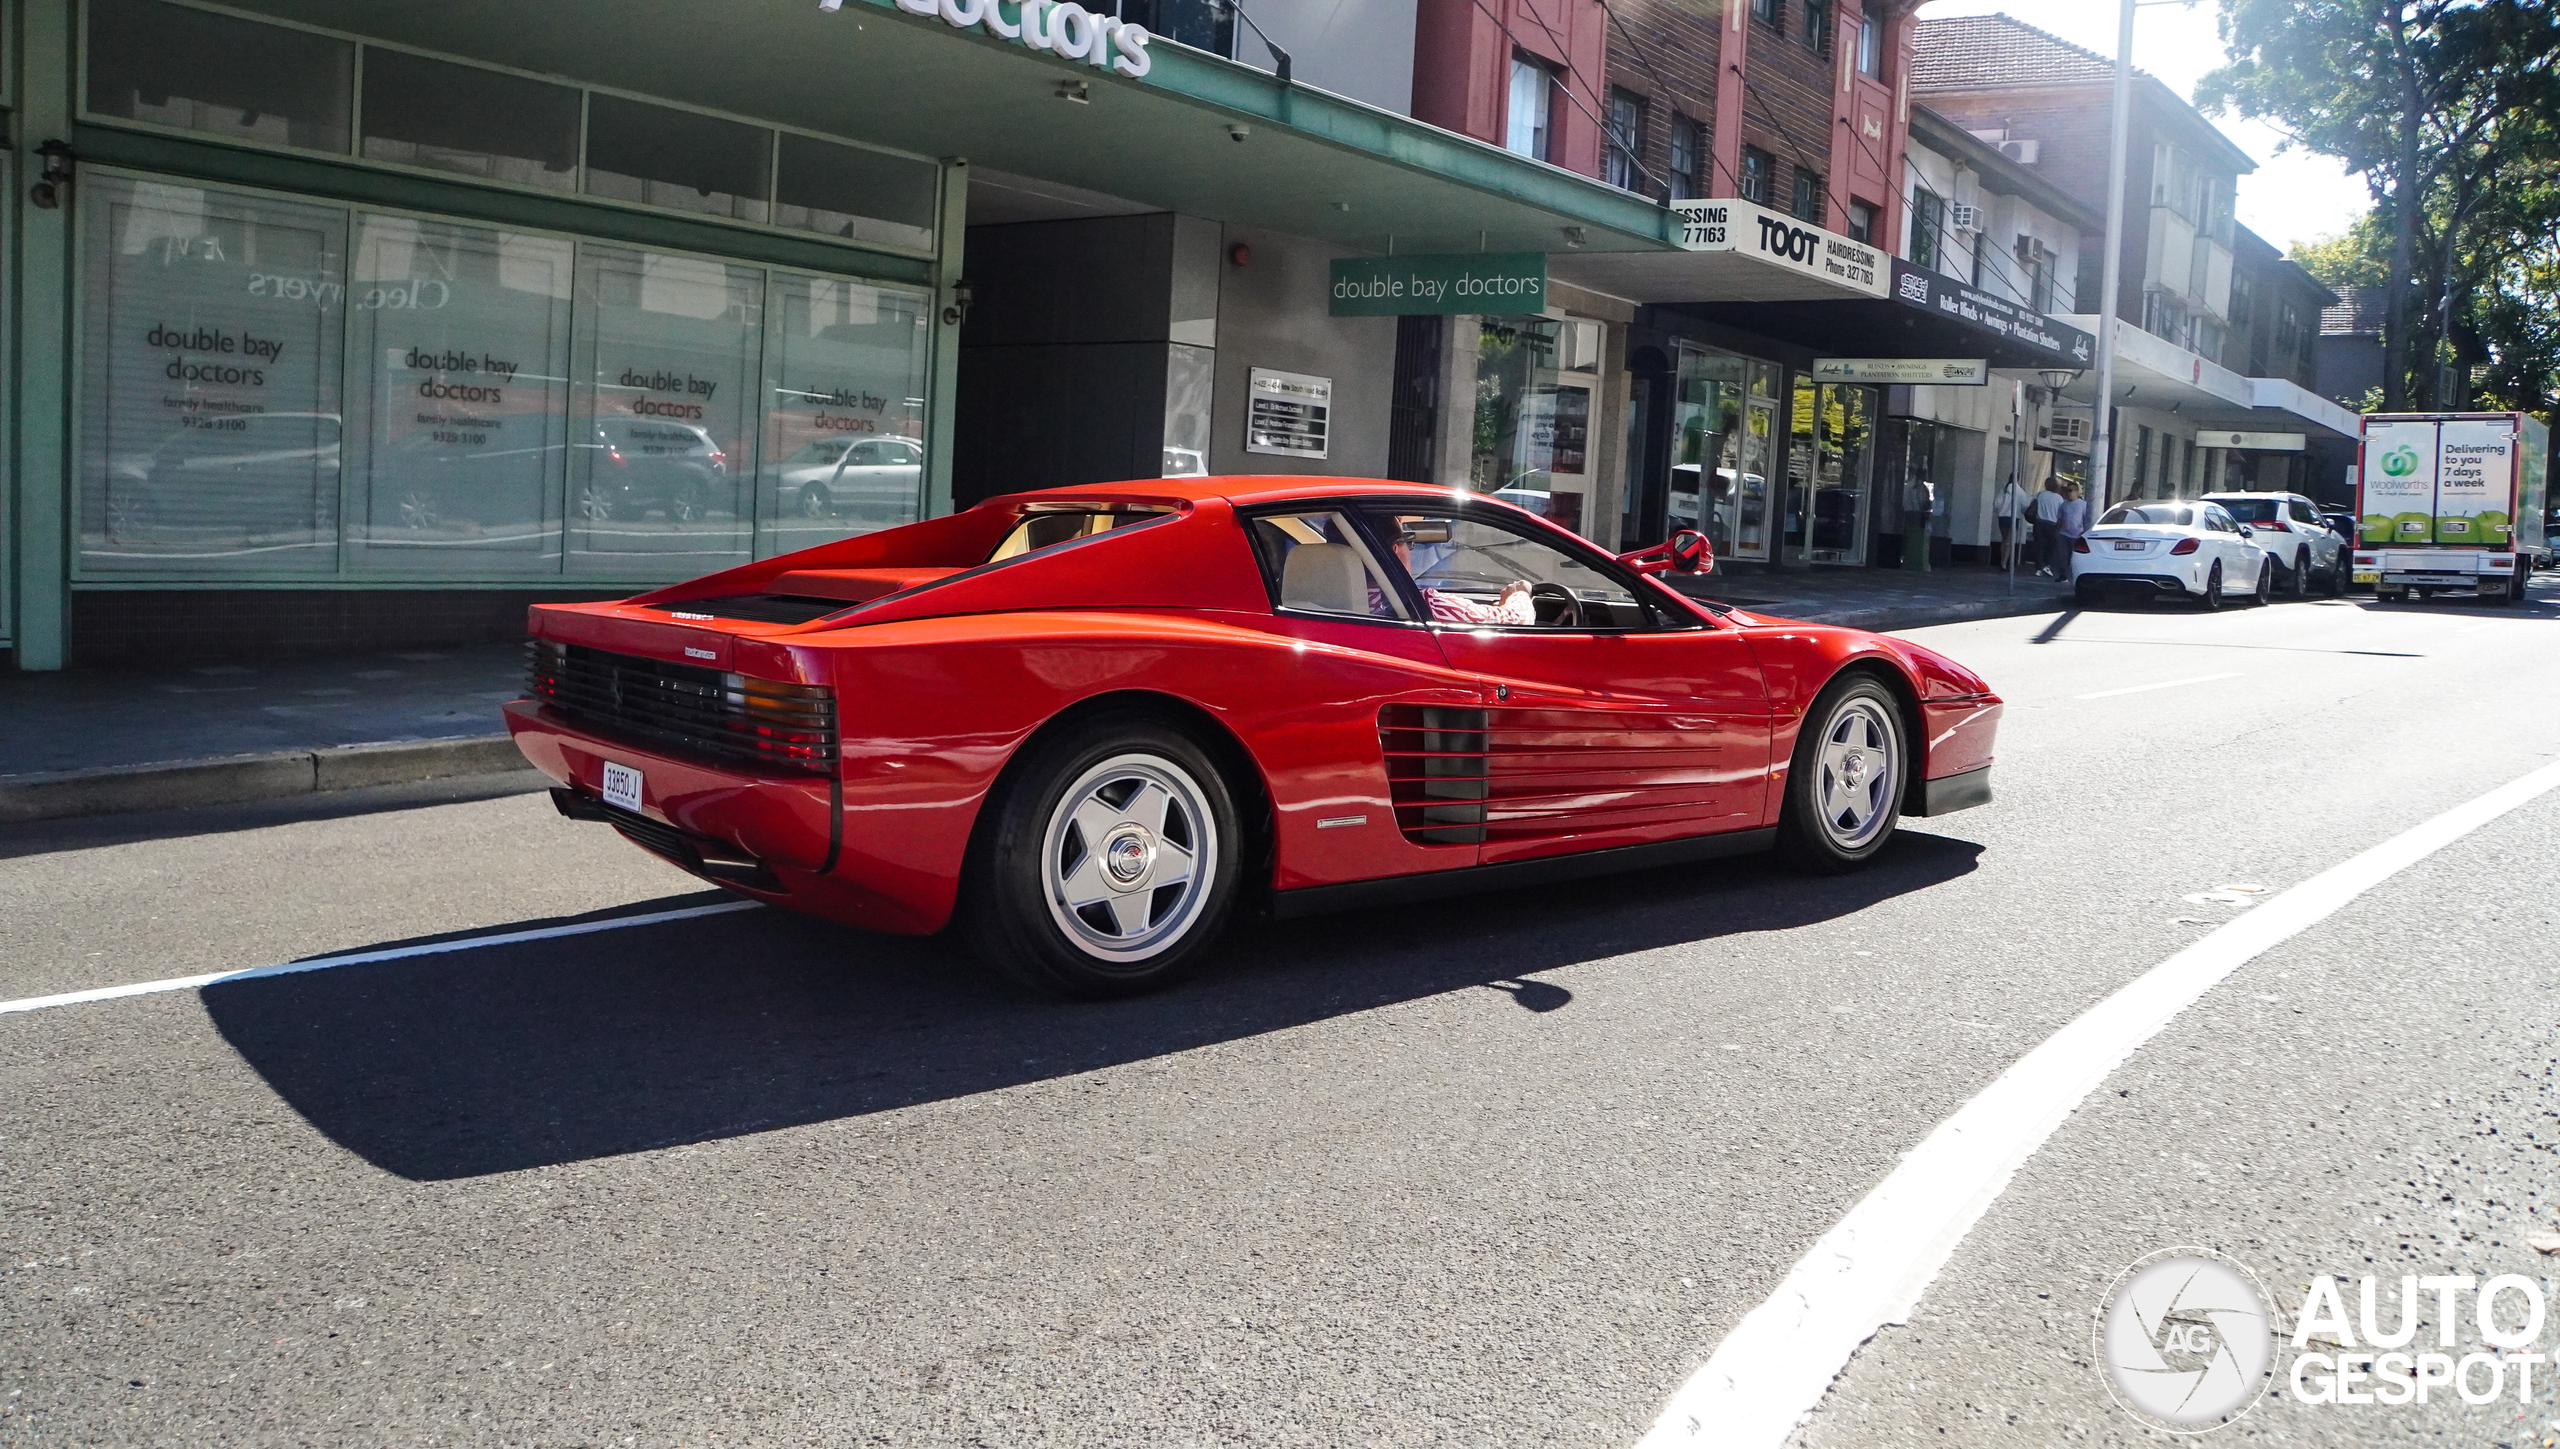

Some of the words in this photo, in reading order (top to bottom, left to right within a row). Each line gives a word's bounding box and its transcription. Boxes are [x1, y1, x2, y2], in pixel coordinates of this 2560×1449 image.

[1676, 207, 1728, 224] SSING
[1695, 227, 1726, 242] 7163
[1757, 215, 1820, 266] TOOT
[1827, 240, 1875, 268] HAIRDRESSING
[1826, 257, 1845, 277] Phone
[1847, 264, 1860, 280] 327
[1861, 268, 1874, 286] 7163
[1334, 274, 1404, 298] double
[1412, 273, 1448, 303] bay
[1455, 272, 1540, 296] doctors
[1940, 294, 1959, 314] Roller
[1960, 301, 1978, 321] Blinds
[1984, 311, 2008, 336] Awnings
[2014, 321, 2039, 344] Plantation
[2040, 332, 2060, 352] Shutters
[148, 323, 234, 353] double
[244, 332, 284, 364] bay
[166, 356, 264, 386] doctors
[405, 346, 477, 372] double
[485, 354, 519, 383] bay
[420, 377, 502, 403] doctors
[620, 367, 683, 392] double
[688, 374, 717, 402] bay
[163, 396, 200, 411] family
[632, 395, 703, 420] doctors
[804, 385, 858, 408] double
[862, 390, 888, 416] bay
[814, 410, 876, 433] doctors
[2445, 456, 2458, 464] to
[2460, 457, 2482, 466] you
[2446, 444, 2506, 456] Delivering
[2444, 467, 2451, 476] 7
[2453, 467, 2482, 478] days
[2454, 478, 2485, 487] week
[607, 768, 629, 797] 33850
[631, 776, 637, 799] J
